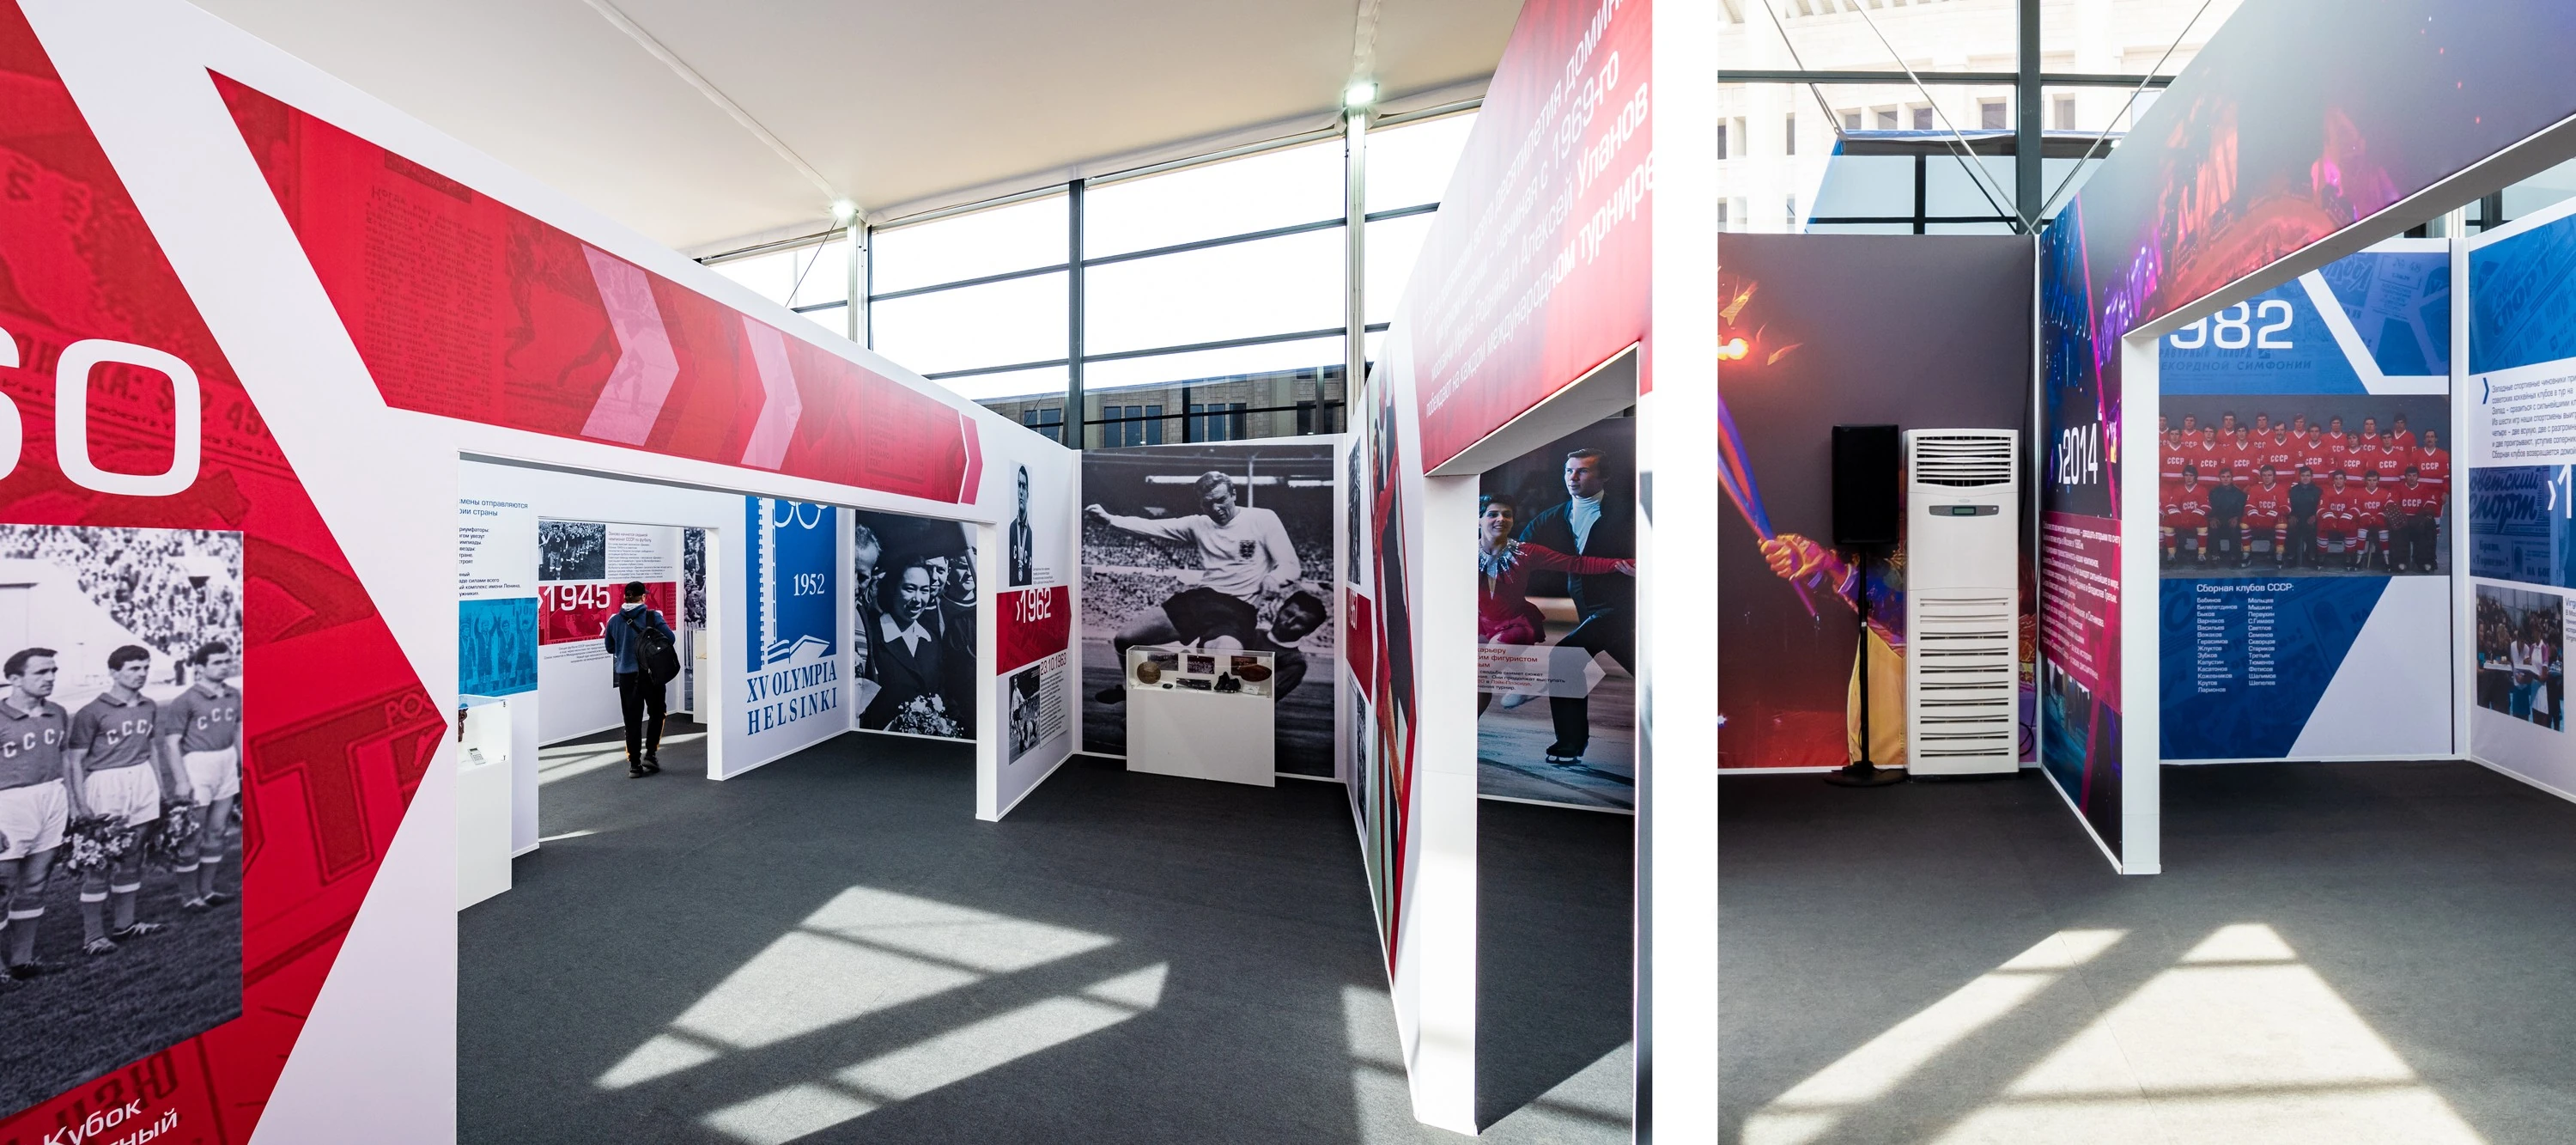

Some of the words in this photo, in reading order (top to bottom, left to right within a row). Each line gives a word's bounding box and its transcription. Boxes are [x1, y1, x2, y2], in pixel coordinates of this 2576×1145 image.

[1495, 79, 1561, 219] десятилетия
[1564, 0, 1623, 102] домин
[1497, 175, 1537, 255] начиная
[1540, 161, 1548, 191] с
[1552, 50, 1619, 169] 1969-го
[1475, 267, 1510, 328] Роднина
[1512, 254, 1518, 283] и
[1521, 171, 1573, 271] Алексей
[1577, 82, 1649, 200] Уланов
[1460, 342, 1485, 384] каждом
[1487, 239, 1576, 357] международном
[1578, 149, 1652, 265] турнире
[2237, 360, 2312, 371] СИМФОНИИ
[2063, 423, 2098, 485] 2014
[473, 509, 498, 517] страны
[544, 584, 611, 612] 1945
[793, 573, 825, 596] 1952
[2196, 583, 2233, 594] Сборная
[2235, 583, 2265, 594] клубов
[2267, 582, 2294, 591] СССР:
[1020, 587, 1051, 624] 1962
[746, 675, 769, 703] XV
[773, 660, 836, 697] OLYMPIA
[1041, 653, 1067, 676] 23.10.1963
[747, 687, 836, 736] HELSINKI
